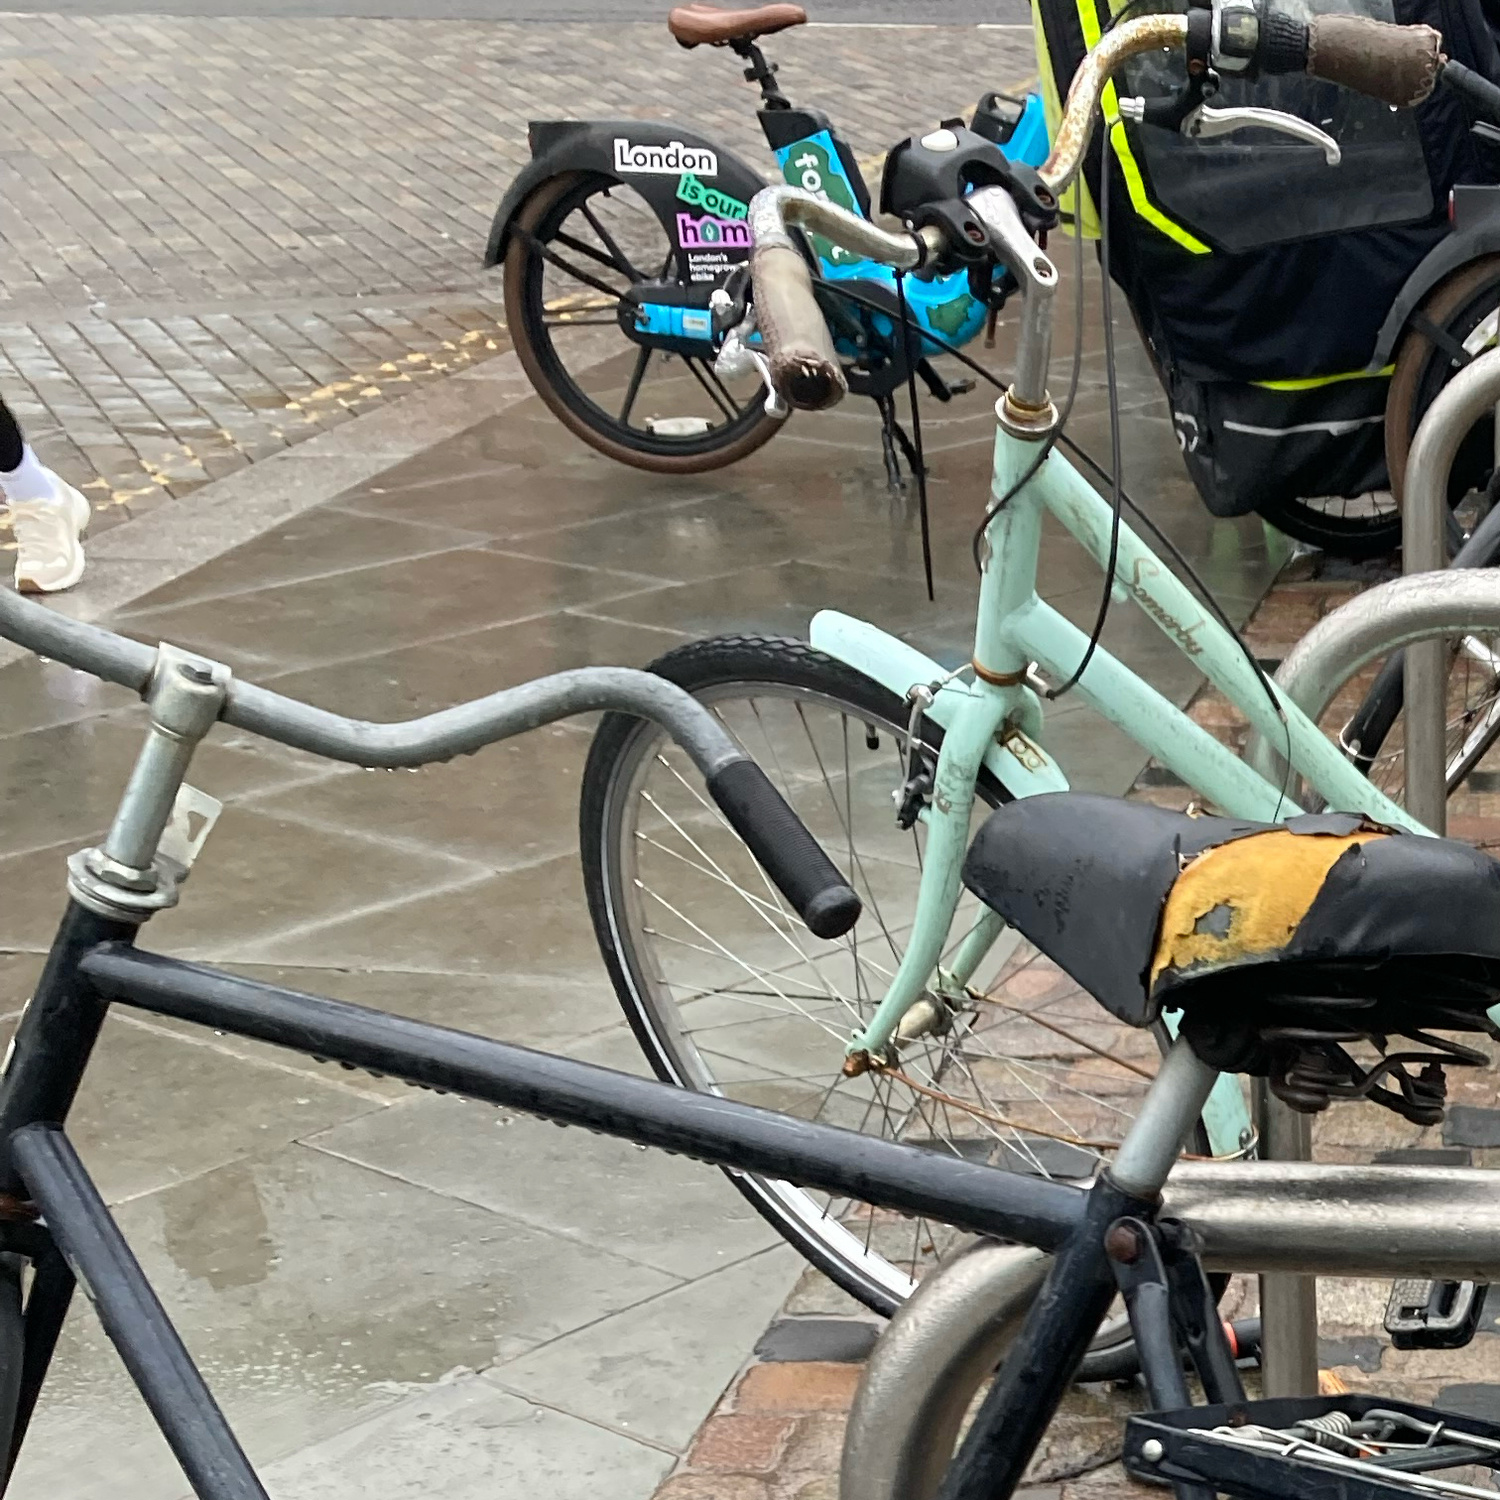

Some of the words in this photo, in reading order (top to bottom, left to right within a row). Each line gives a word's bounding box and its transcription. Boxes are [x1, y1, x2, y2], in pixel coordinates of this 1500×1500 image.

[620, 144, 712, 170] London
[681, 176, 699, 200] is
[705, 192, 742, 218] our
[681, 218, 748, 243] hom
